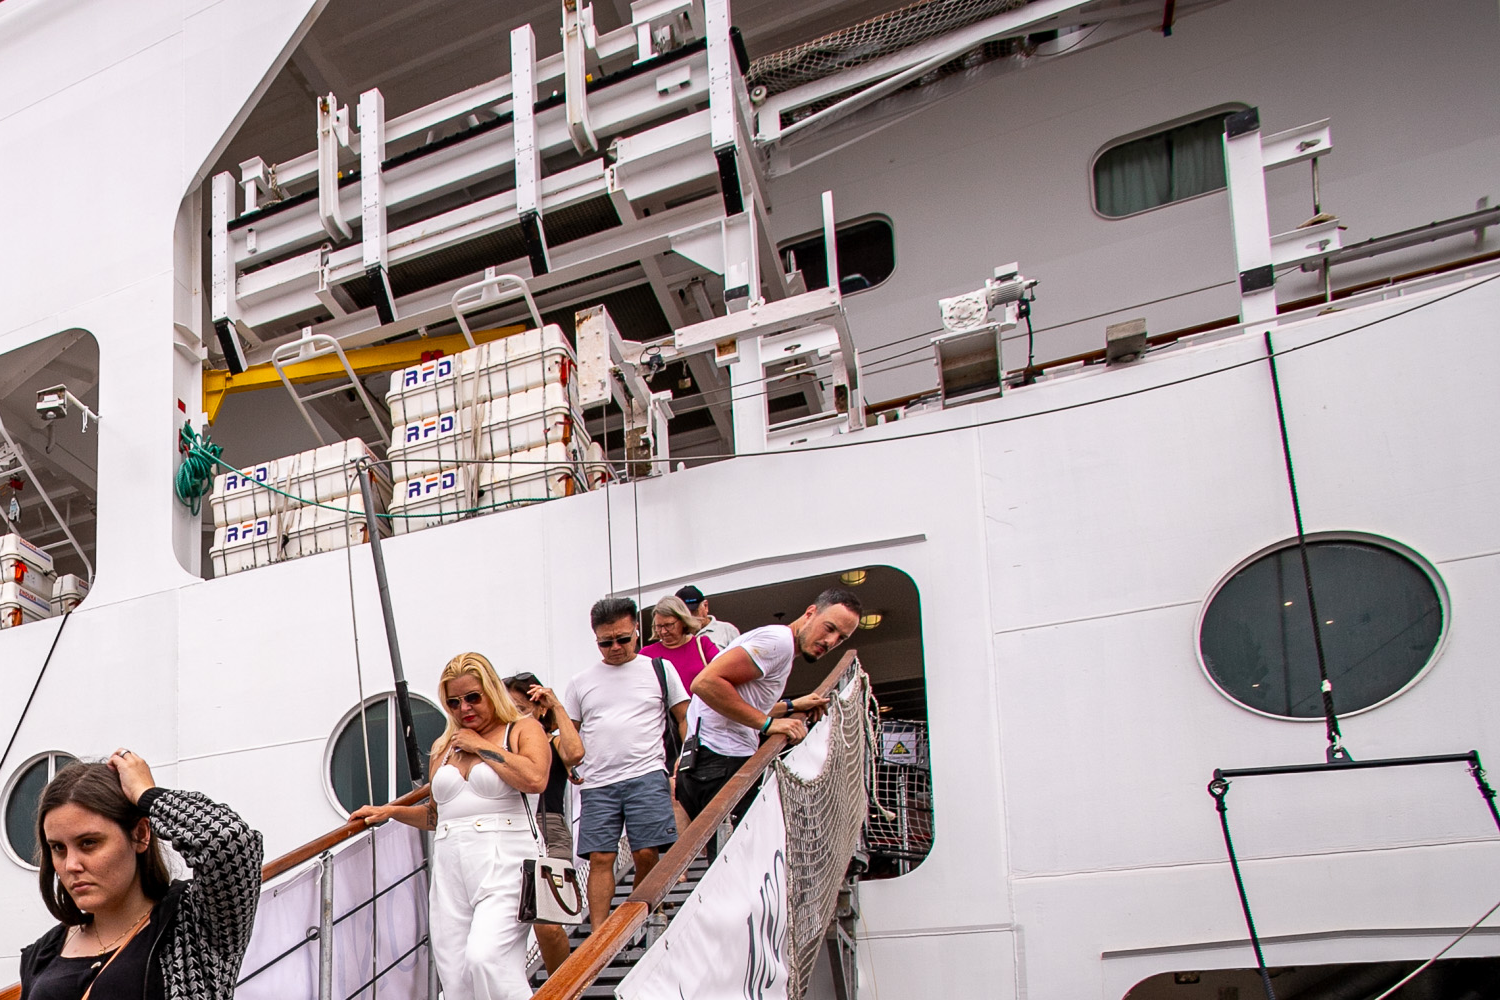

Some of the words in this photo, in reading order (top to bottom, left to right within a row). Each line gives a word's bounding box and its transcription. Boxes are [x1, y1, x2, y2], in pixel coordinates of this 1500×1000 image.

[404, 359, 452, 387] RFD
[406, 415, 454, 443] RFD
[226, 466, 268, 491] RFD
[407, 471, 456, 499] RFD
[227, 520, 268, 543] RFD
